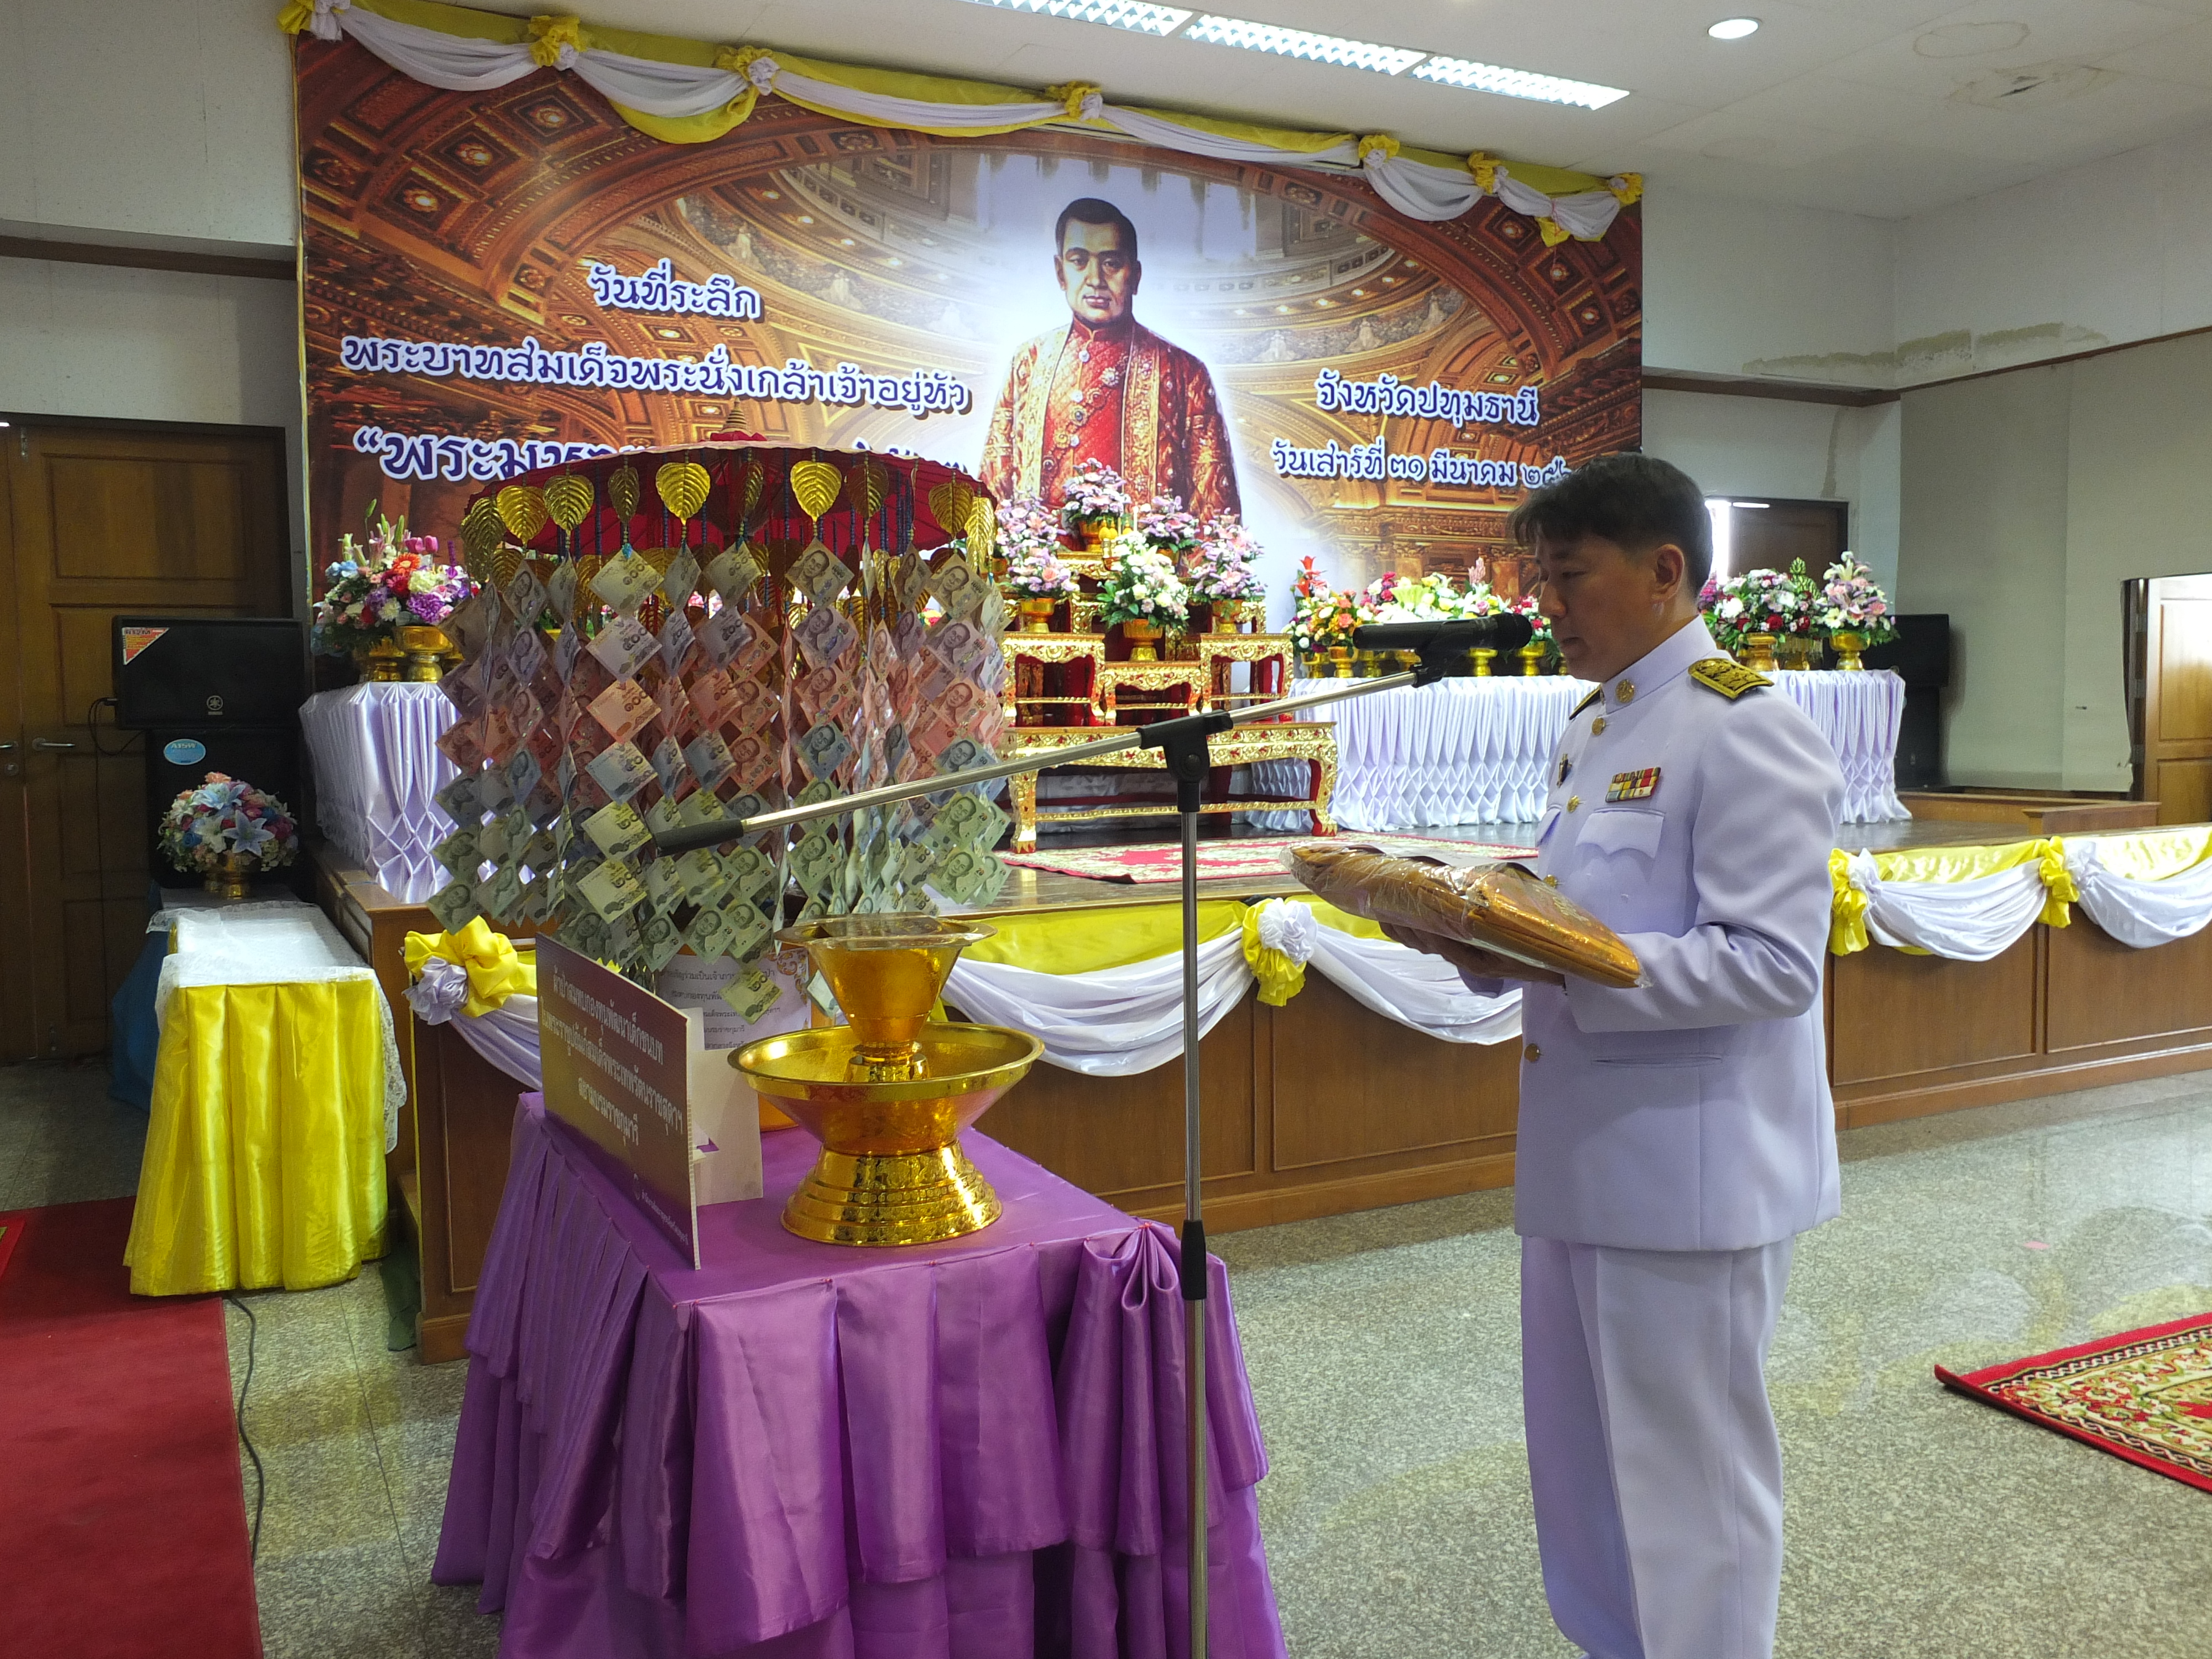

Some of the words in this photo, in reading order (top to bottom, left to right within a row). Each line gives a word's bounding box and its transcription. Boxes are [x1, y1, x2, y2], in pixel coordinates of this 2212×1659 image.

[588, 260, 760, 320] วันที่ระลึก
[344, 337, 968, 413] พระบาทสมเด็จพระนั่งเกล้าเจ้าอยู่หัว
[1317, 369, 1537, 426] จังหวัดปทุมธานี
[1273, 437, 1384, 478] วันเสาร์ที่
[1389, 461, 1425, 479] ๓๑
[1431, 448, 1515, 484] มีนาคม
[971, 581, 984, 594] 1000
[760, 639, 771, 650] 100
[624, 691, 647, 712] ๑๐๐
[977, 698, 987, 708] 100
[979, 756, 988, 765] 50
[617, 813, 639, 830] ๒๐
[978, 812, 988, 821] 20
[828, 854, 836, 863] 20
[916, 849, 931, 863] ๒๐
[761, 868, 771, 877] 20
[975, 868, 984, 876] 20
[611, 872, 633, 888] ๒๐
[916, 894, 931, 910] ๒๐
[757, 921, 766, 930] 20
[748, 975, 768, 992] ๒๐
